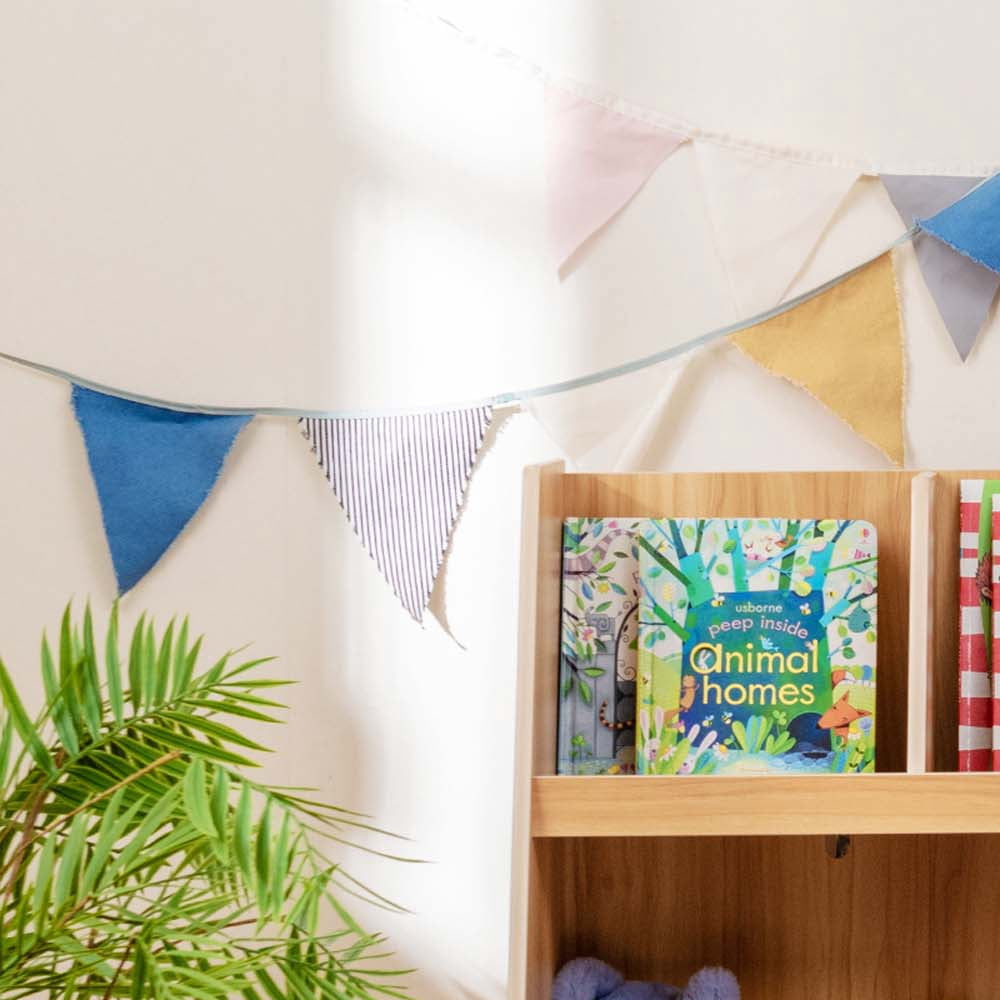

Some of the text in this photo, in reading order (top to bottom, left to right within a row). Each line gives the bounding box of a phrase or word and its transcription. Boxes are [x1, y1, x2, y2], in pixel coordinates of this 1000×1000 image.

[735, 601, 783, 613] usborne
[708, 615, 808, 639] peep inside
[689, 639, 818, 674] animal
[702, 674, 815, 706] homes
